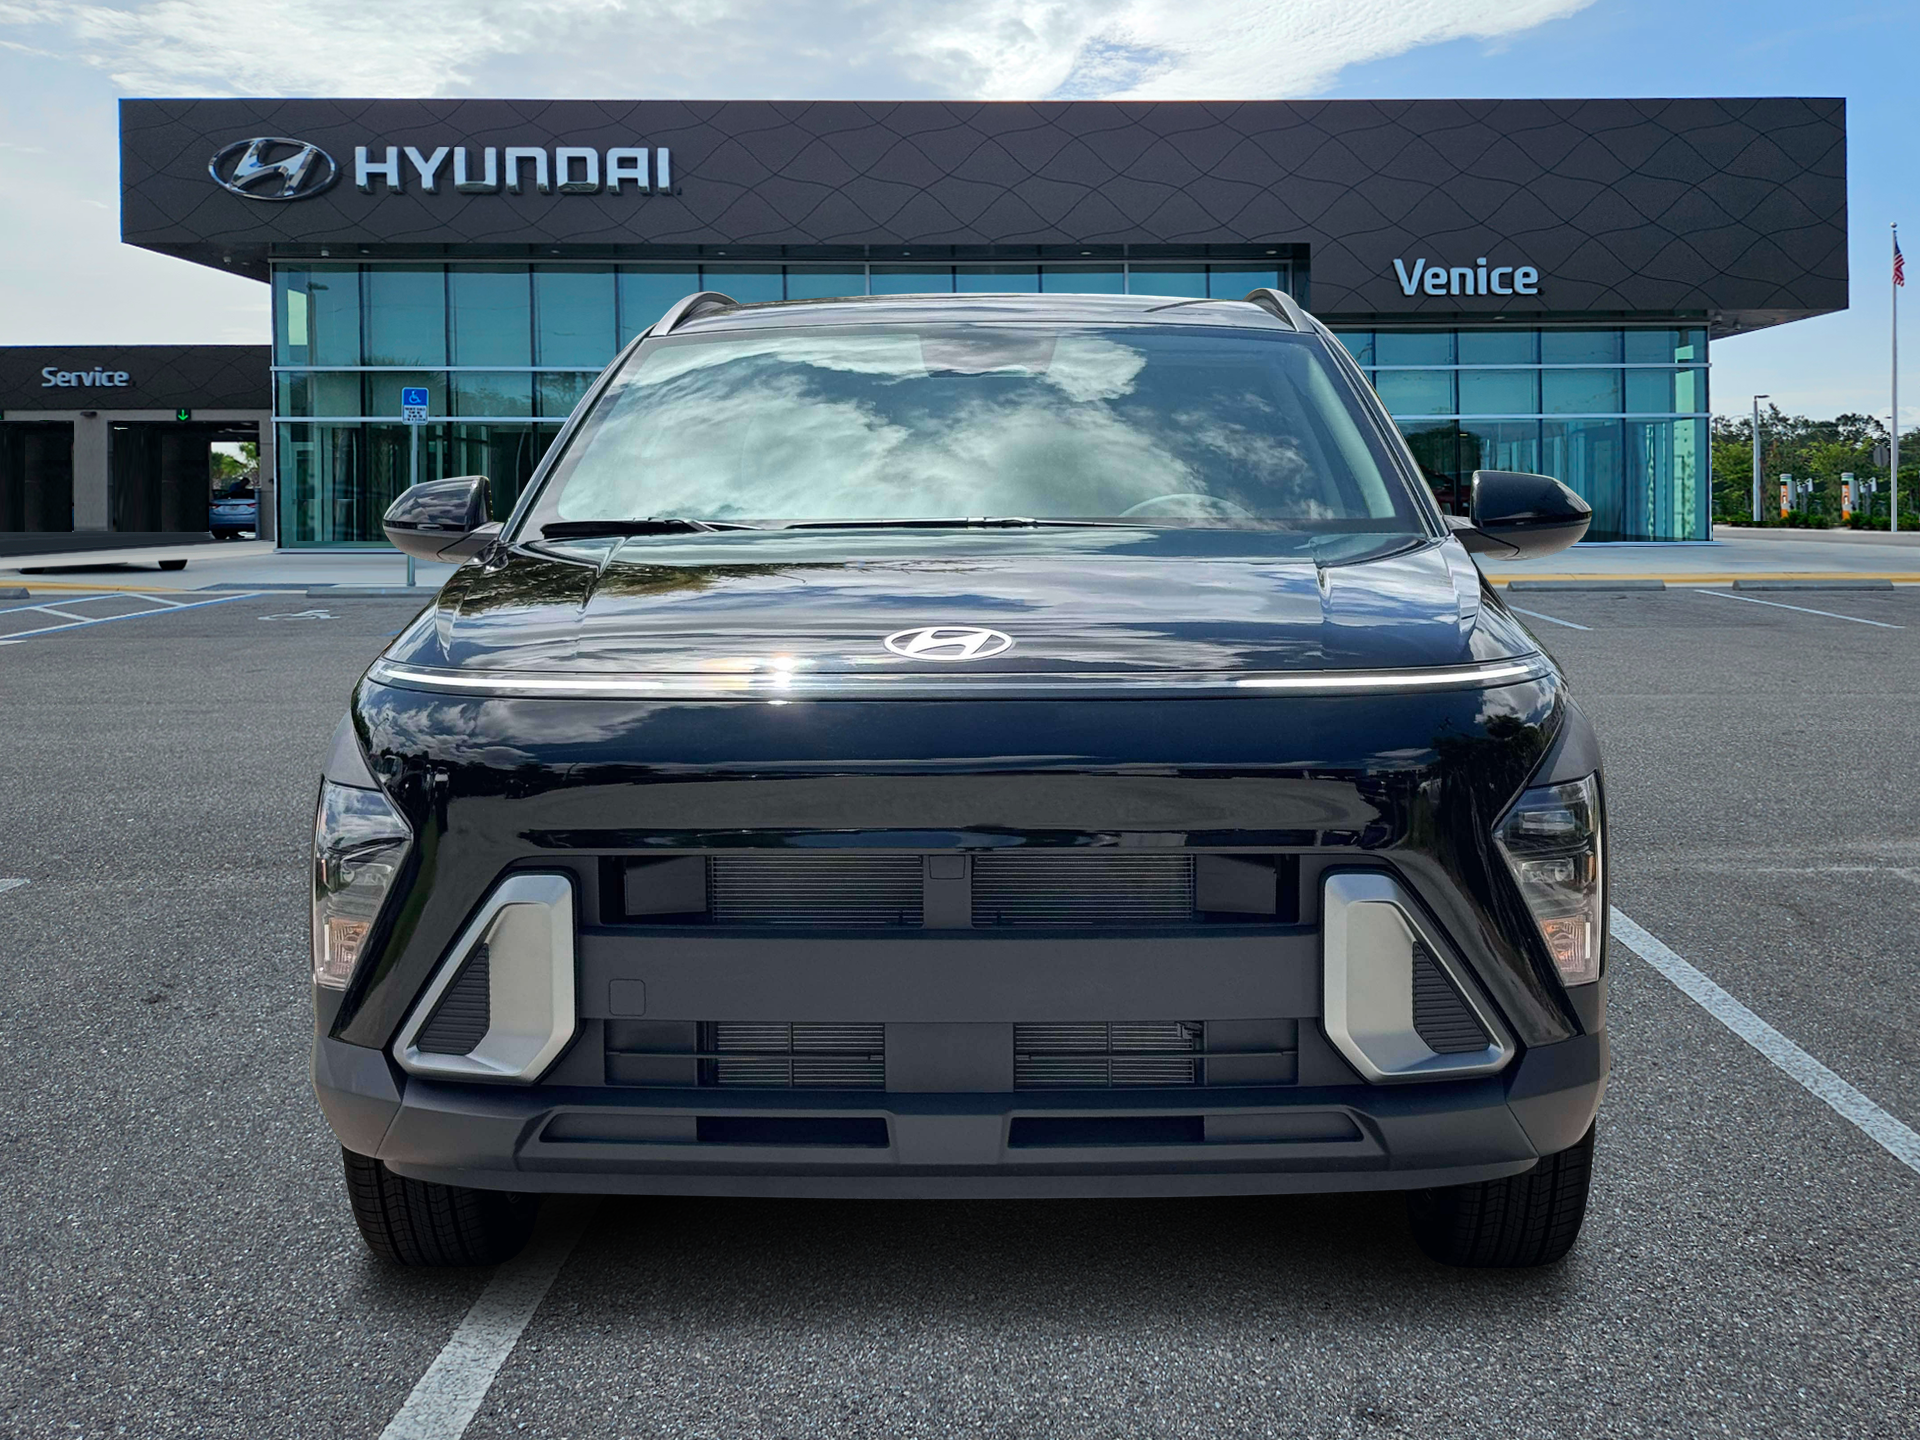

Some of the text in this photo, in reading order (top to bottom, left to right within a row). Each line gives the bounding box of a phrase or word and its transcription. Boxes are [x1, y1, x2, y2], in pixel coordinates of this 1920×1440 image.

[354, 146, 672, 193] HYUNDAI
[1393, 257, 1539, 296] Venice
[41, 366, 130, 388] Service
